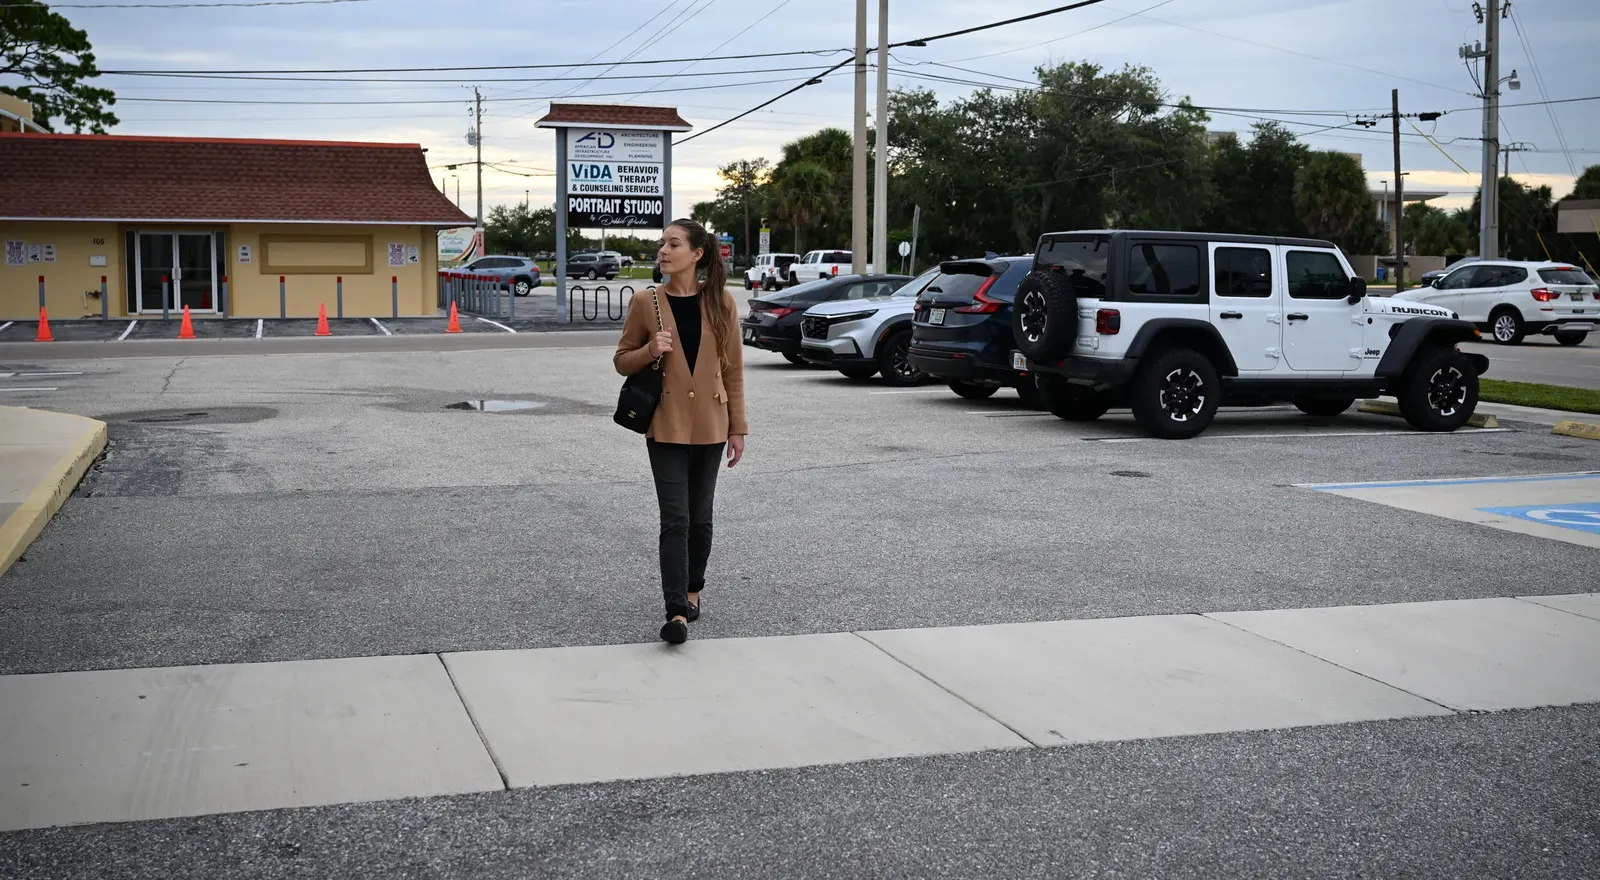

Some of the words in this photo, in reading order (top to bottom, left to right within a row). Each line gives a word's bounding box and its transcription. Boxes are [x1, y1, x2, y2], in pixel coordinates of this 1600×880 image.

[617, 165, 659, 174] BEHAVIOR
[619, 175, 657, 183] THERAPY
[580, 184, 623, 193] COUNSELING
[625, 185, 659, 193] SERVICES
[569, 198, 621, 213] PORTRAIT
[624, 199, 662, 215] STUDIO
[1391, 307, 1448, 316] RUBICON
[1365, 348, 1380, 356] Jeep
